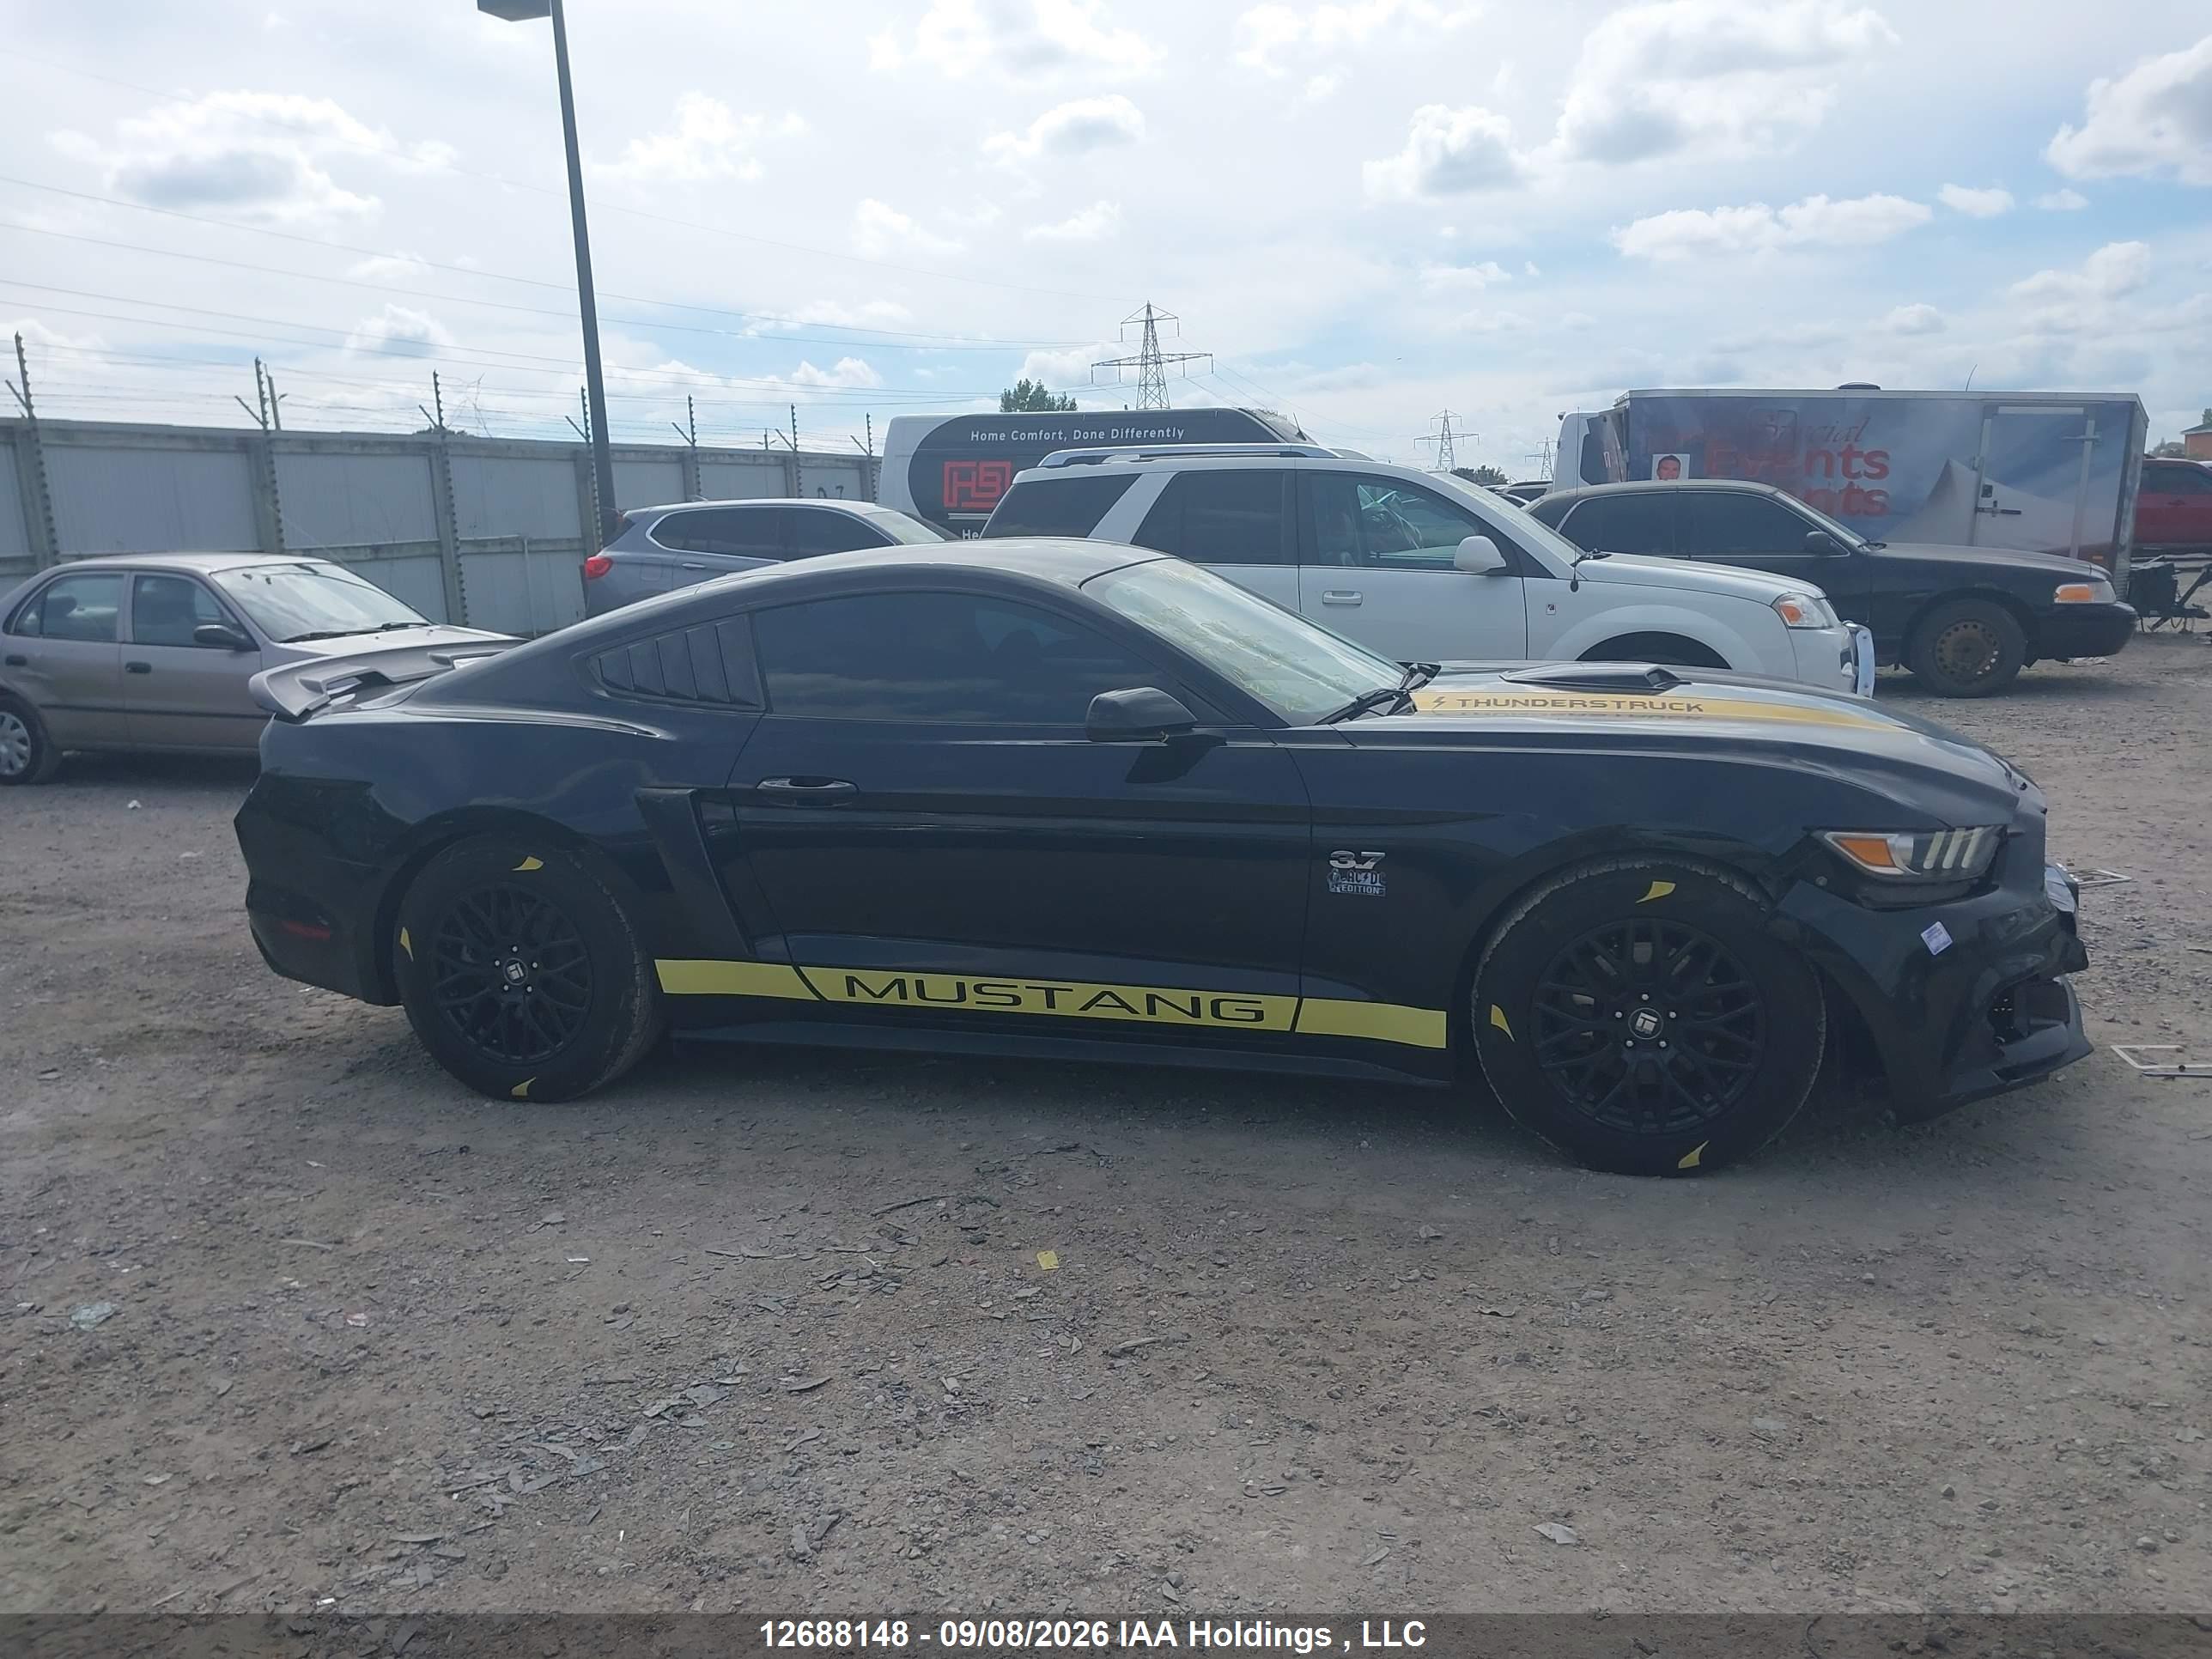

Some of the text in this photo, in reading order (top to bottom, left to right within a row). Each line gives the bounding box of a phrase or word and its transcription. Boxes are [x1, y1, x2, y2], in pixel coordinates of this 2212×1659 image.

[970, 427, 1185, 442] Home Comfort, Done Differently
[1456, 697, 1705, 713] THUNDERSTRUCK
[1328, 850, 1386, 870] 3.7
[1341, 884, 1380, 895] EDITION
[844, 975, 1266, 1024] MUSTANG
